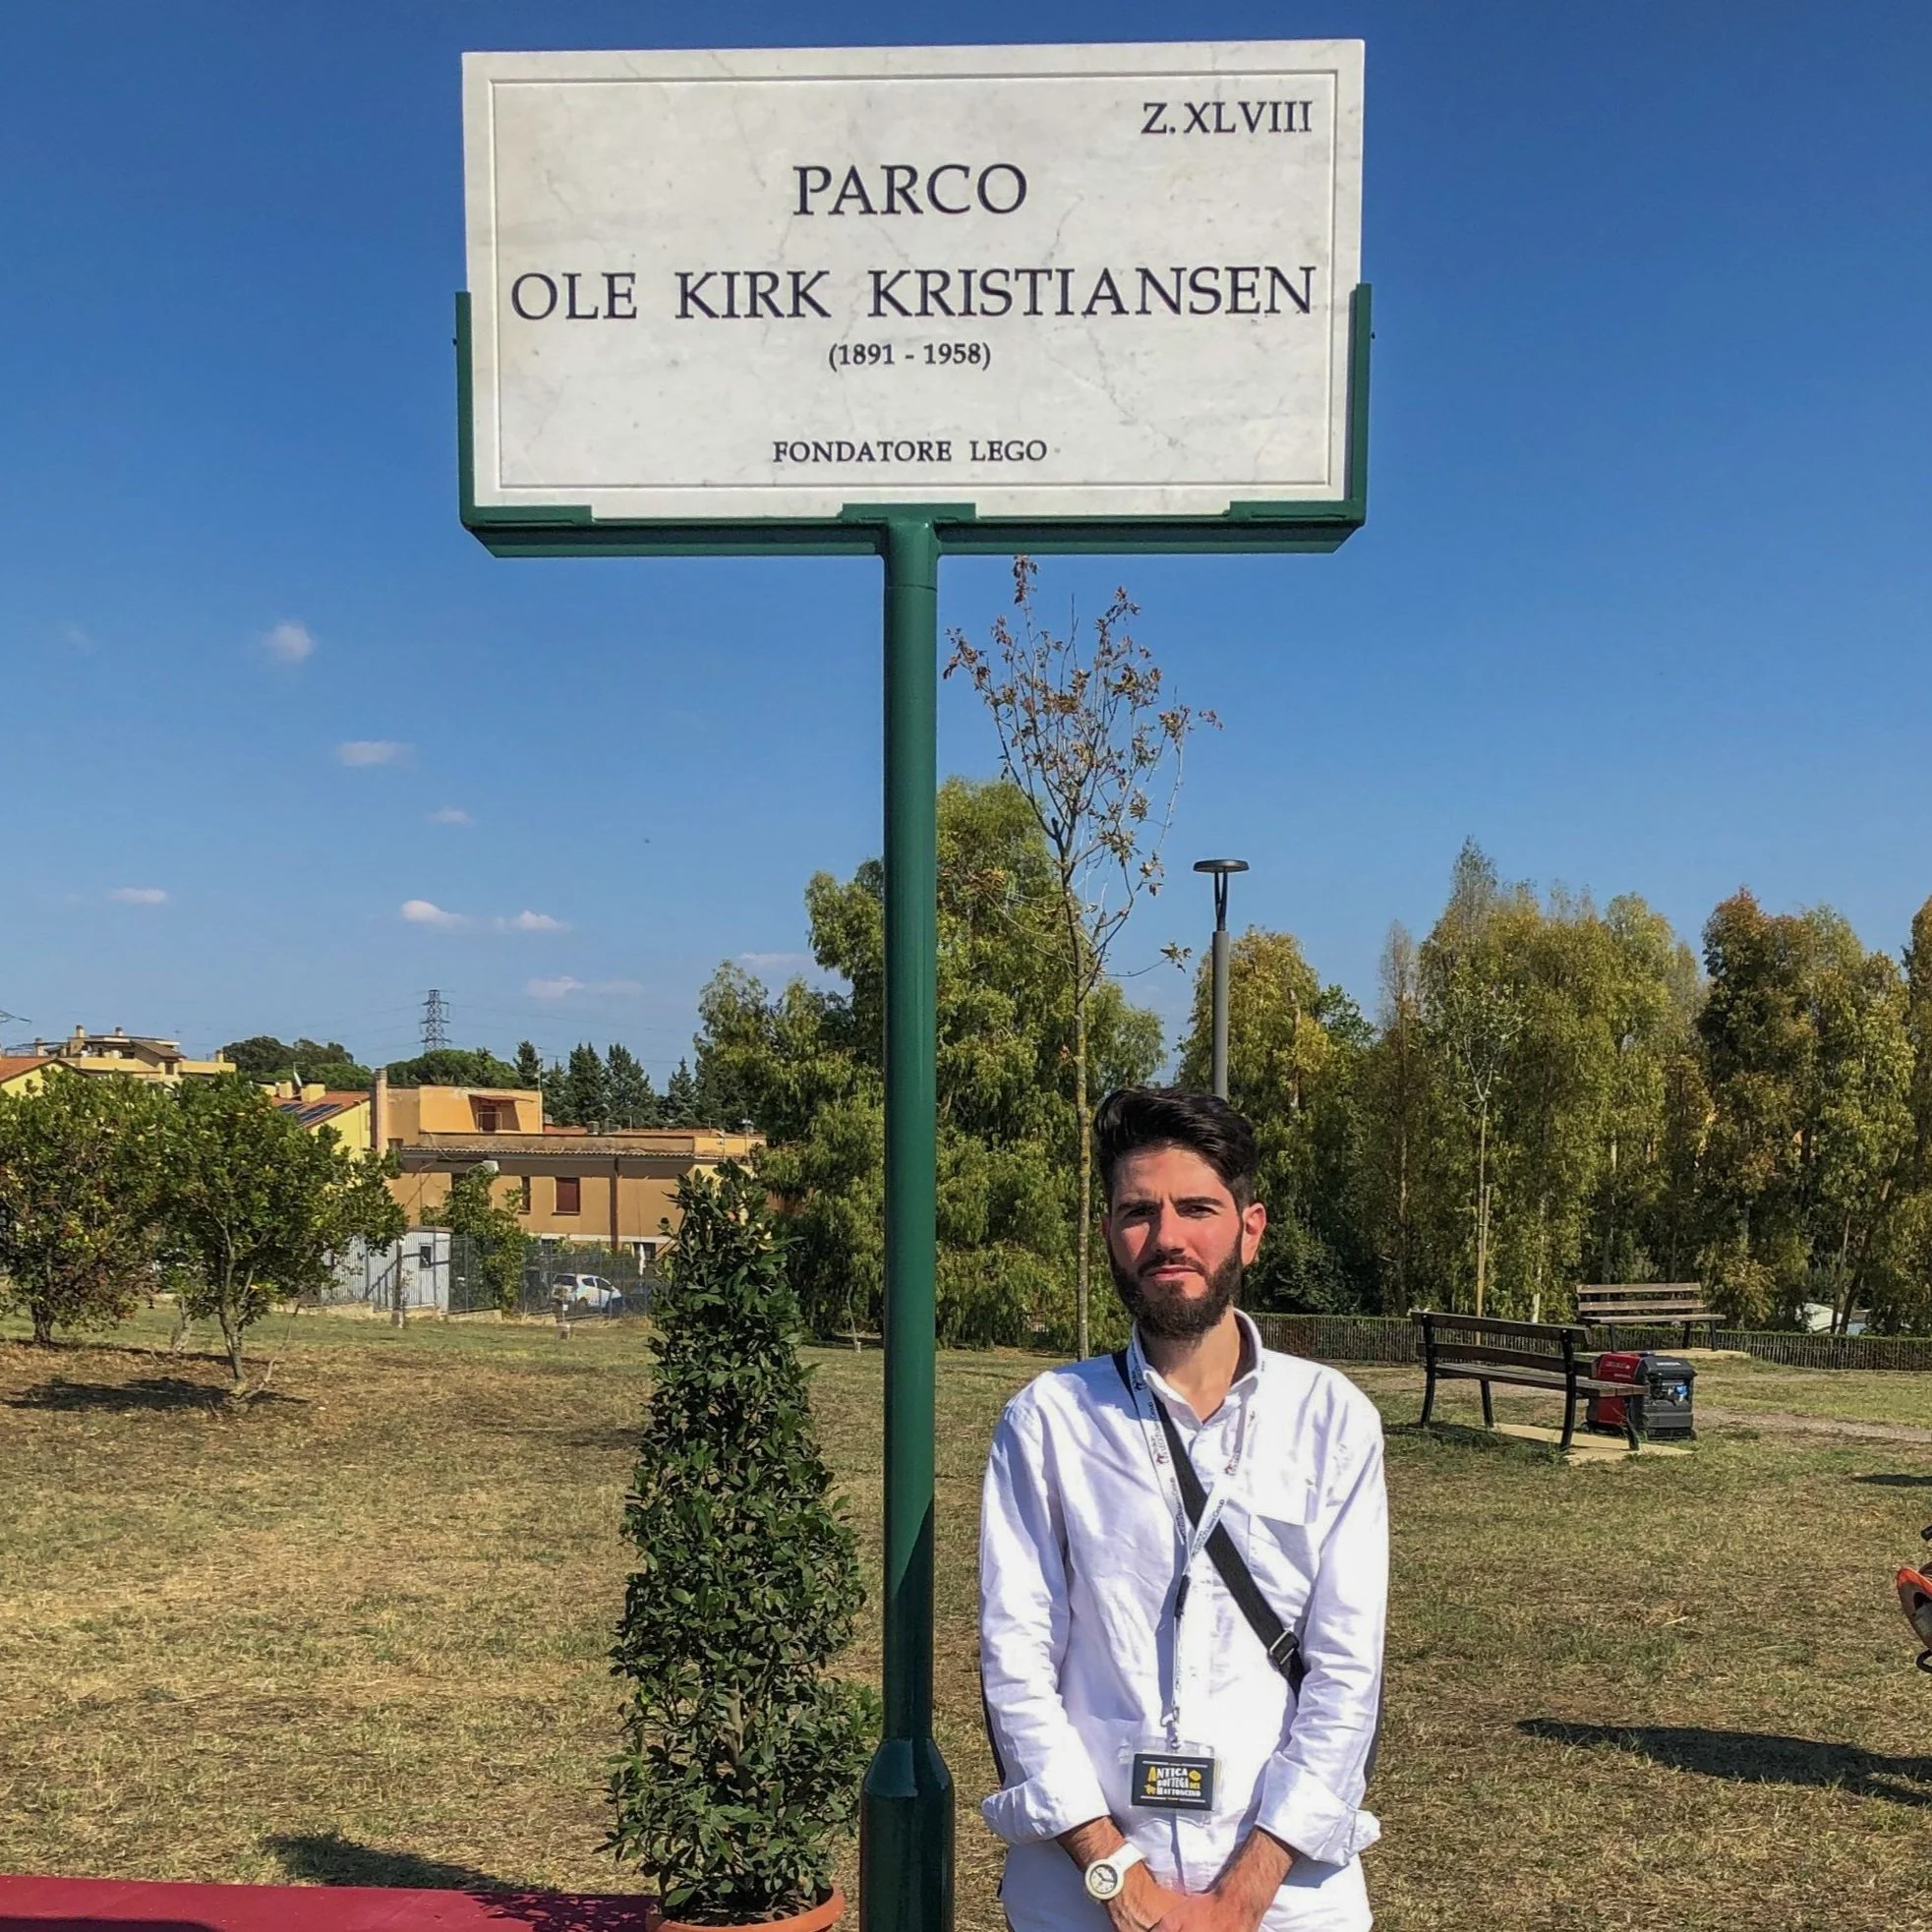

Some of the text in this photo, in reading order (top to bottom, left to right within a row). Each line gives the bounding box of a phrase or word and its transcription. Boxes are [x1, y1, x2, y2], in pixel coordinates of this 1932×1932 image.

[791, 162, 1027, 216] PARCO
[510, 264, 1317, 322] OLE KIRK KRISTIANSEN
[828, 342, 896, 373] (1891
[923, 341, 991, 372] 1958)
[772, 439, 1049, 463] FONDATORE LEGO
